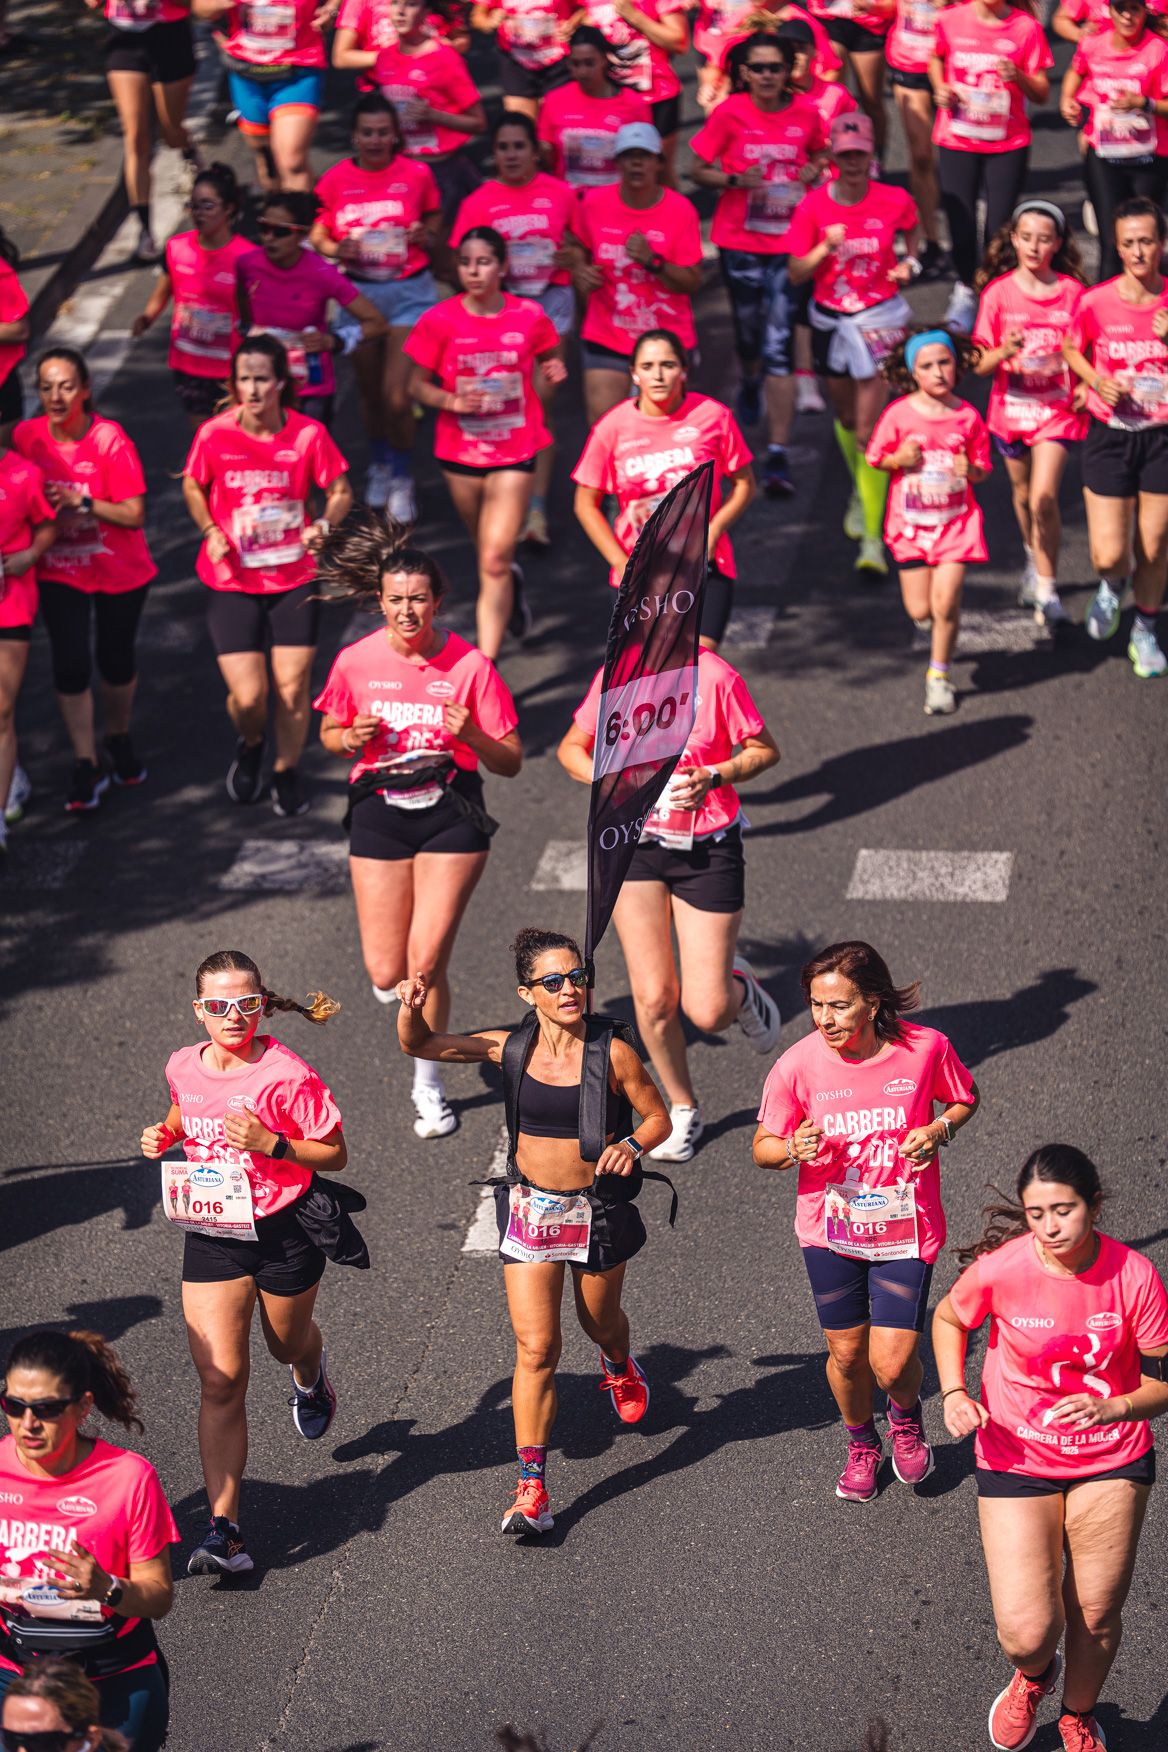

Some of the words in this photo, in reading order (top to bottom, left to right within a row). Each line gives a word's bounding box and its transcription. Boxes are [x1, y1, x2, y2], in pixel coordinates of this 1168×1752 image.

[623, 590, 695, 631] SHO
[368, 680, 402, 690] OYSHO
[370, 700, 444, 727] CARRERA
[599, 817, 643, 850] OYS
[180, 1094, 204, 1104] YSHO
[816, 1088, 853, 1102] OYSHO
[181, 1115, 226, 1139] ARRE
[823, 1106, 908, 1138] CARRERA
[869, 1139, 895, 1168] DE
[193, 1173, 222, 1184] ASTURIANA
[192, 1200, 224, 1215] 016
[852, 1199, 886, 1208] ASTURIANA
[527, 1224, 561, 1238] 016
[852, 1221, 887, 1235] 016
[881, 1249, 908, 1257] Santander
[1011, 1316, 1055, 1329] OYSHO
[1017, 1425, 1058, 1445] CARRERA
[1060, 1435, 1073, 1446] DE
[1075, 1434, 1087, 1445] LA
[1088, 1429, 1120, 1444] MUJER
[1060, 1445, 1079, 1455] 2025
[0, 1492, 23, 1505] SHO
[0, 1519, 79, 1556] ARRERA
[26, 1592, 58, 1601] ASTURIA
